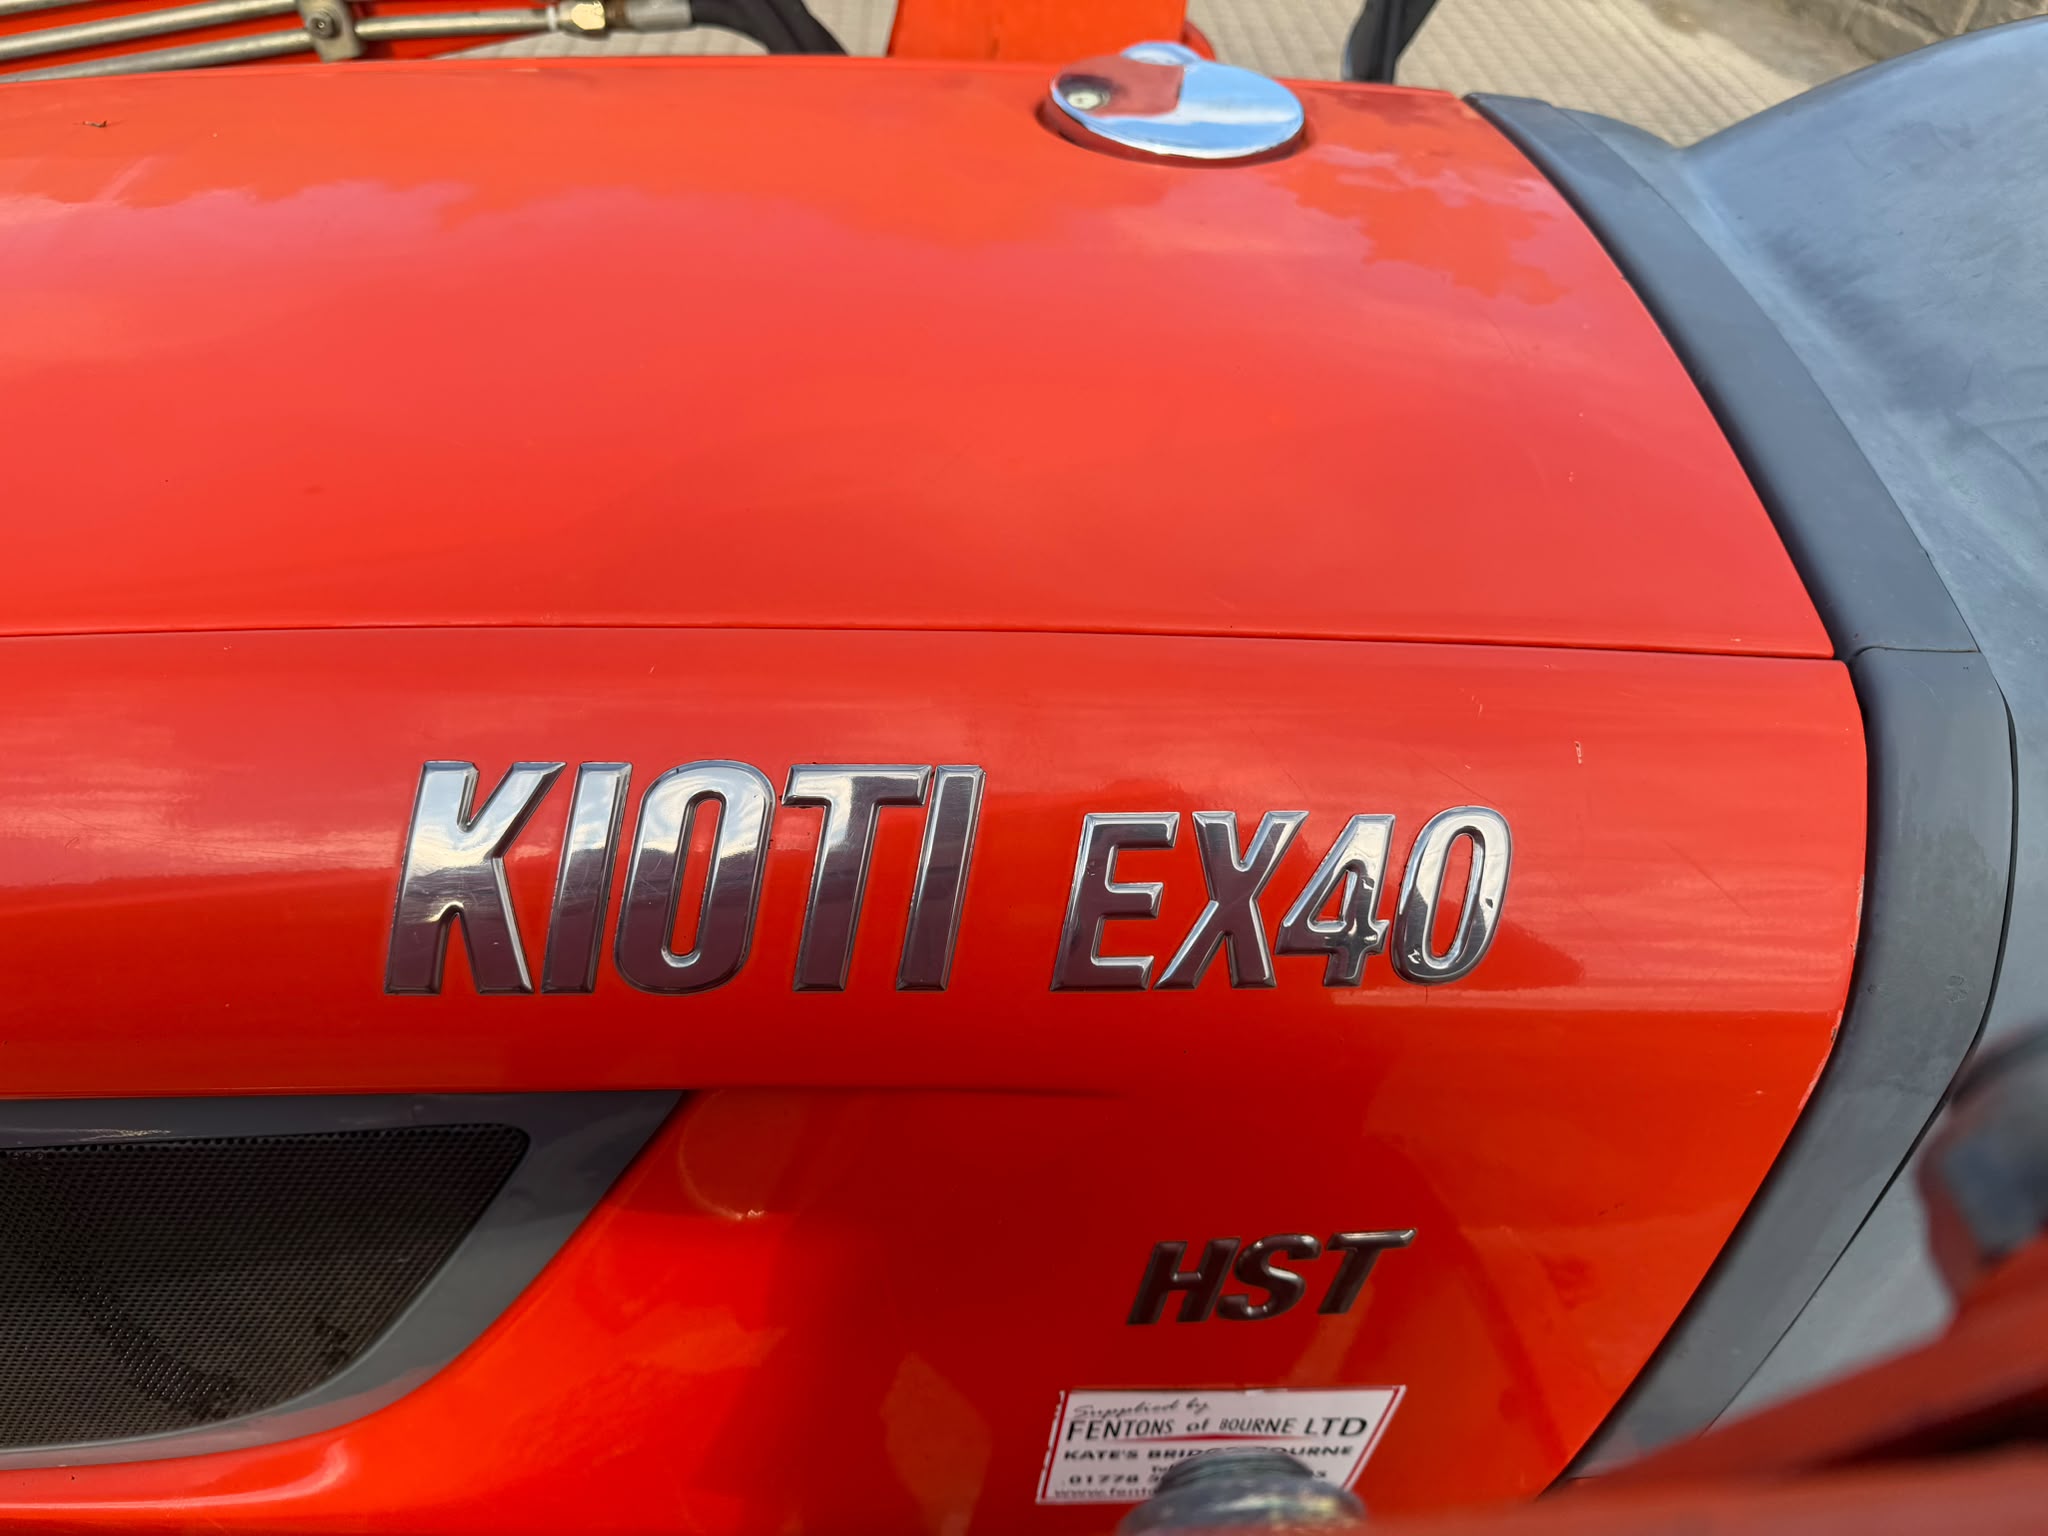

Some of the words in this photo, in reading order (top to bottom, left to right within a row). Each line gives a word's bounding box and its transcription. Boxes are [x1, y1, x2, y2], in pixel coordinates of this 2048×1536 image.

[383, 759, 986, 996] KIOTI
[1050, 805, 1513, 991] EX40
[1126, 1227, 1418, 1326] HST
[1073, 1398, 1180, 1420] Supplied
[1186, 1397, 1210, 1414] by
[1066, 1418, 1174, 1441] FENTONS
[1186, 1417, 1209, 1433] of
[1219, 1417, 1297, 1434] BOURNE
[1304, 1416, 1368, 1437] LTD
[1063, 1450, 1138, 1460] KATE'S
